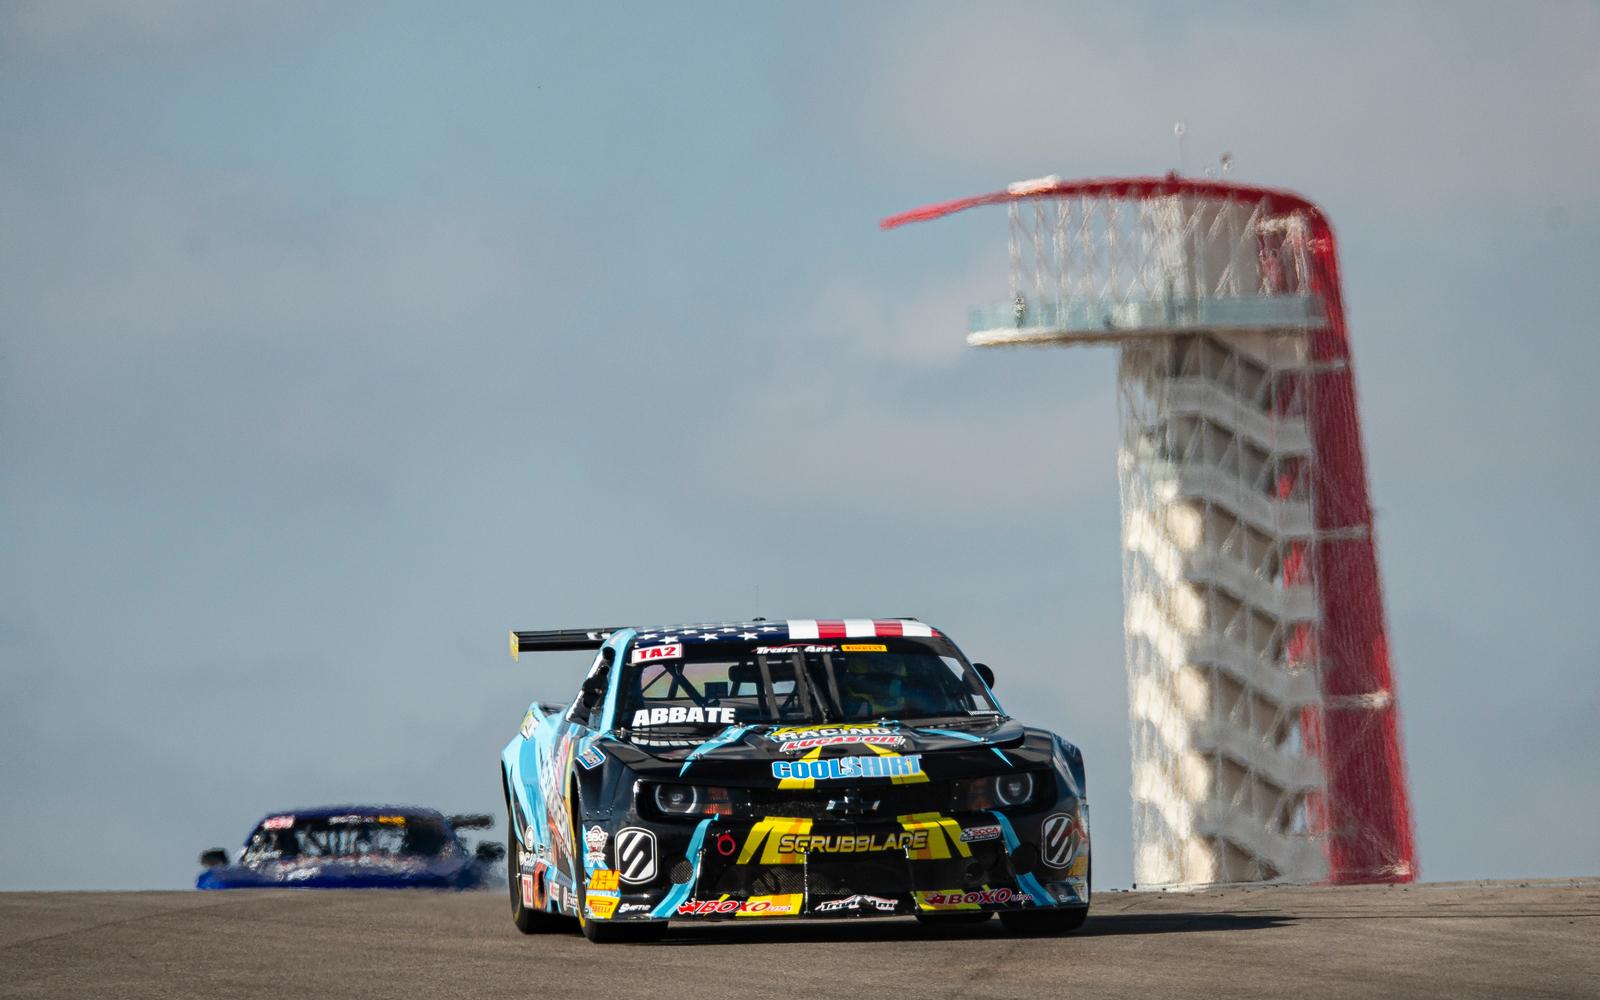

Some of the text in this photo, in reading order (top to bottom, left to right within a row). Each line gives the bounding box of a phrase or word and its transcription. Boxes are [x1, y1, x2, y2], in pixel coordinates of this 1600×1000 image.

[638, 646, 678, 660] TA2
[632, 707, 736, 727] ABBATE
[778, 728, 893, 740] RACING
[785, 735, 896, 750] LUCAS OIL
[771, 754, 922, 780] COOLSHIRT
[778, 830, 929, 854] SCRUBBLADE
[946, 888, 1012, 905] BOXO
[701, 900, 770, 913] BOXO
